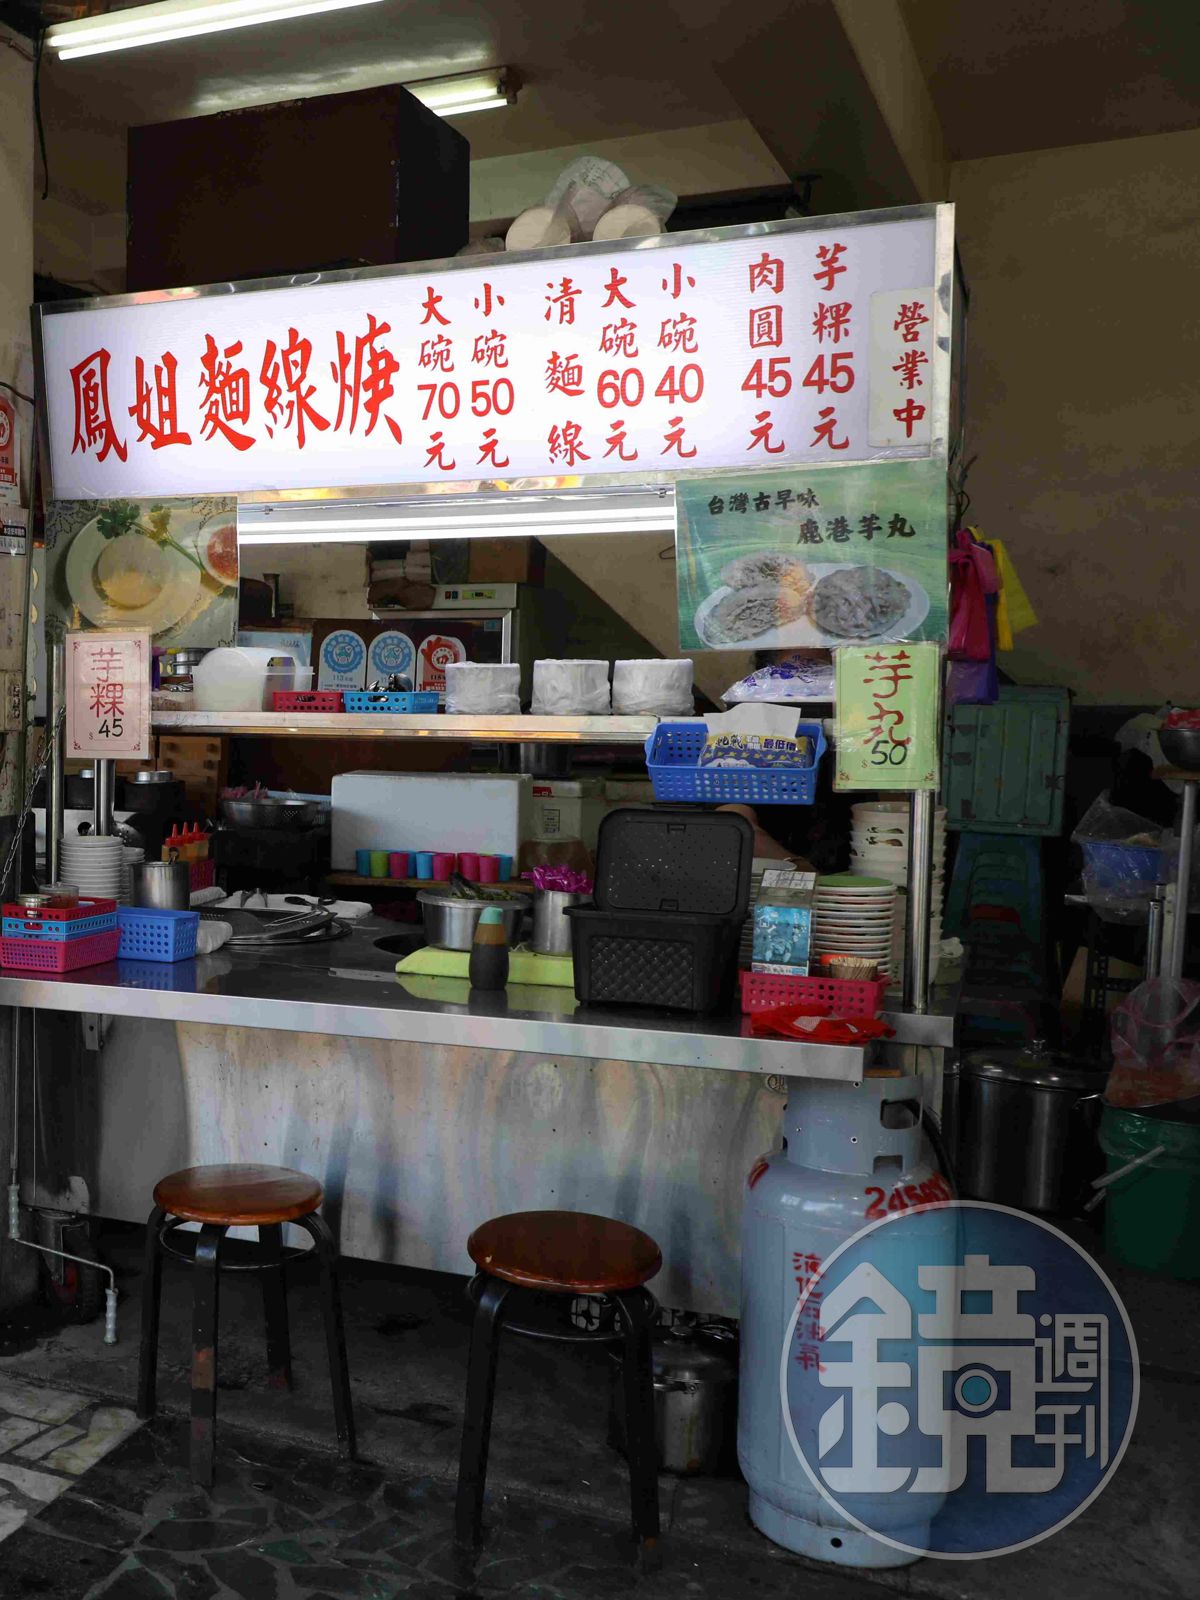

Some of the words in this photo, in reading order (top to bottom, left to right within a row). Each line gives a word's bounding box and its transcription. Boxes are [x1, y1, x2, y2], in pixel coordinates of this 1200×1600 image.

[417, 286, 460, 471] 大碗70元
[471, 283, 515, 468] 小碗50元
[544, 277, 591, 467] 清麵線
[597, 267, 644, 461] 大碗60元
[654, 263, 705, 458] 小碗40元
[741, 252, 792, 454] 肉圓45元
[802, 243, 855, 450] 芋粿45元
[892, 301, 930, 438] 營業中
[708, 488, 820, 515] 台灣古早味
[796, 513, 915, 544] 鹿港芋丸
[89, 648, 125, 718] 芋粿
[863, 650, 913, 746] 芋丸
